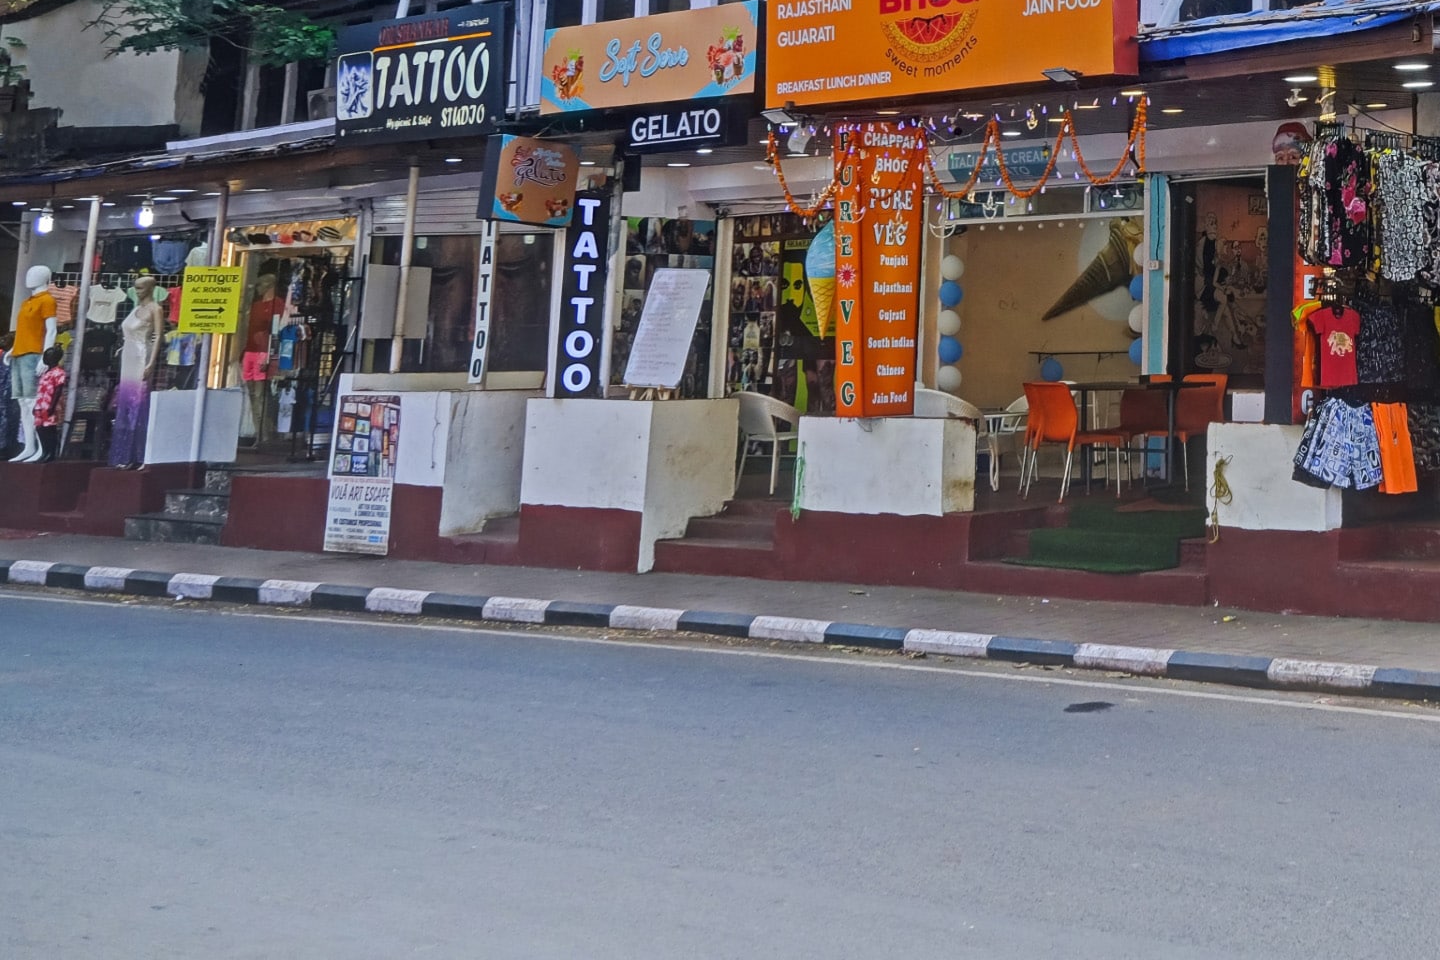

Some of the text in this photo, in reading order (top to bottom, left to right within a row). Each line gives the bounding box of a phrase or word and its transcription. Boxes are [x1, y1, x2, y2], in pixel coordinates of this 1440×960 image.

[777, 25, 835, 48] GUJARATI
[599, 32, 689, 88] Soft Serve
[885, 35, 978, 78] sweet moments
[375, 42, 490, 110] TATTOO
[776, 71, 892, 95] BREAKFAST LUNCH DINNER
[631, 108, 721, 142] GELATO
[869, 187, 913, 211] PURE
[873, 221, 908, 246] VEG
[879, 253, 909, 269] Punjabi
[186, 274, 240, 286] BOUTIQUE
[202, 286, 233, 294] ROOMS
[873, 281, 913, 296] Rajasthani
[471, 219, 493, 378] TATTOO
[562, 198, 601, 392] TATTOO
[878, 309, 906, 324] Gujrati
[867, 336, 890, 349] South
[876, 364, 905, 377] Chinese
[871, 391, 908, 405] Jain Food
[347, 485, 364, 501] ART
[364, 486, 391, 503] ESCAPE
